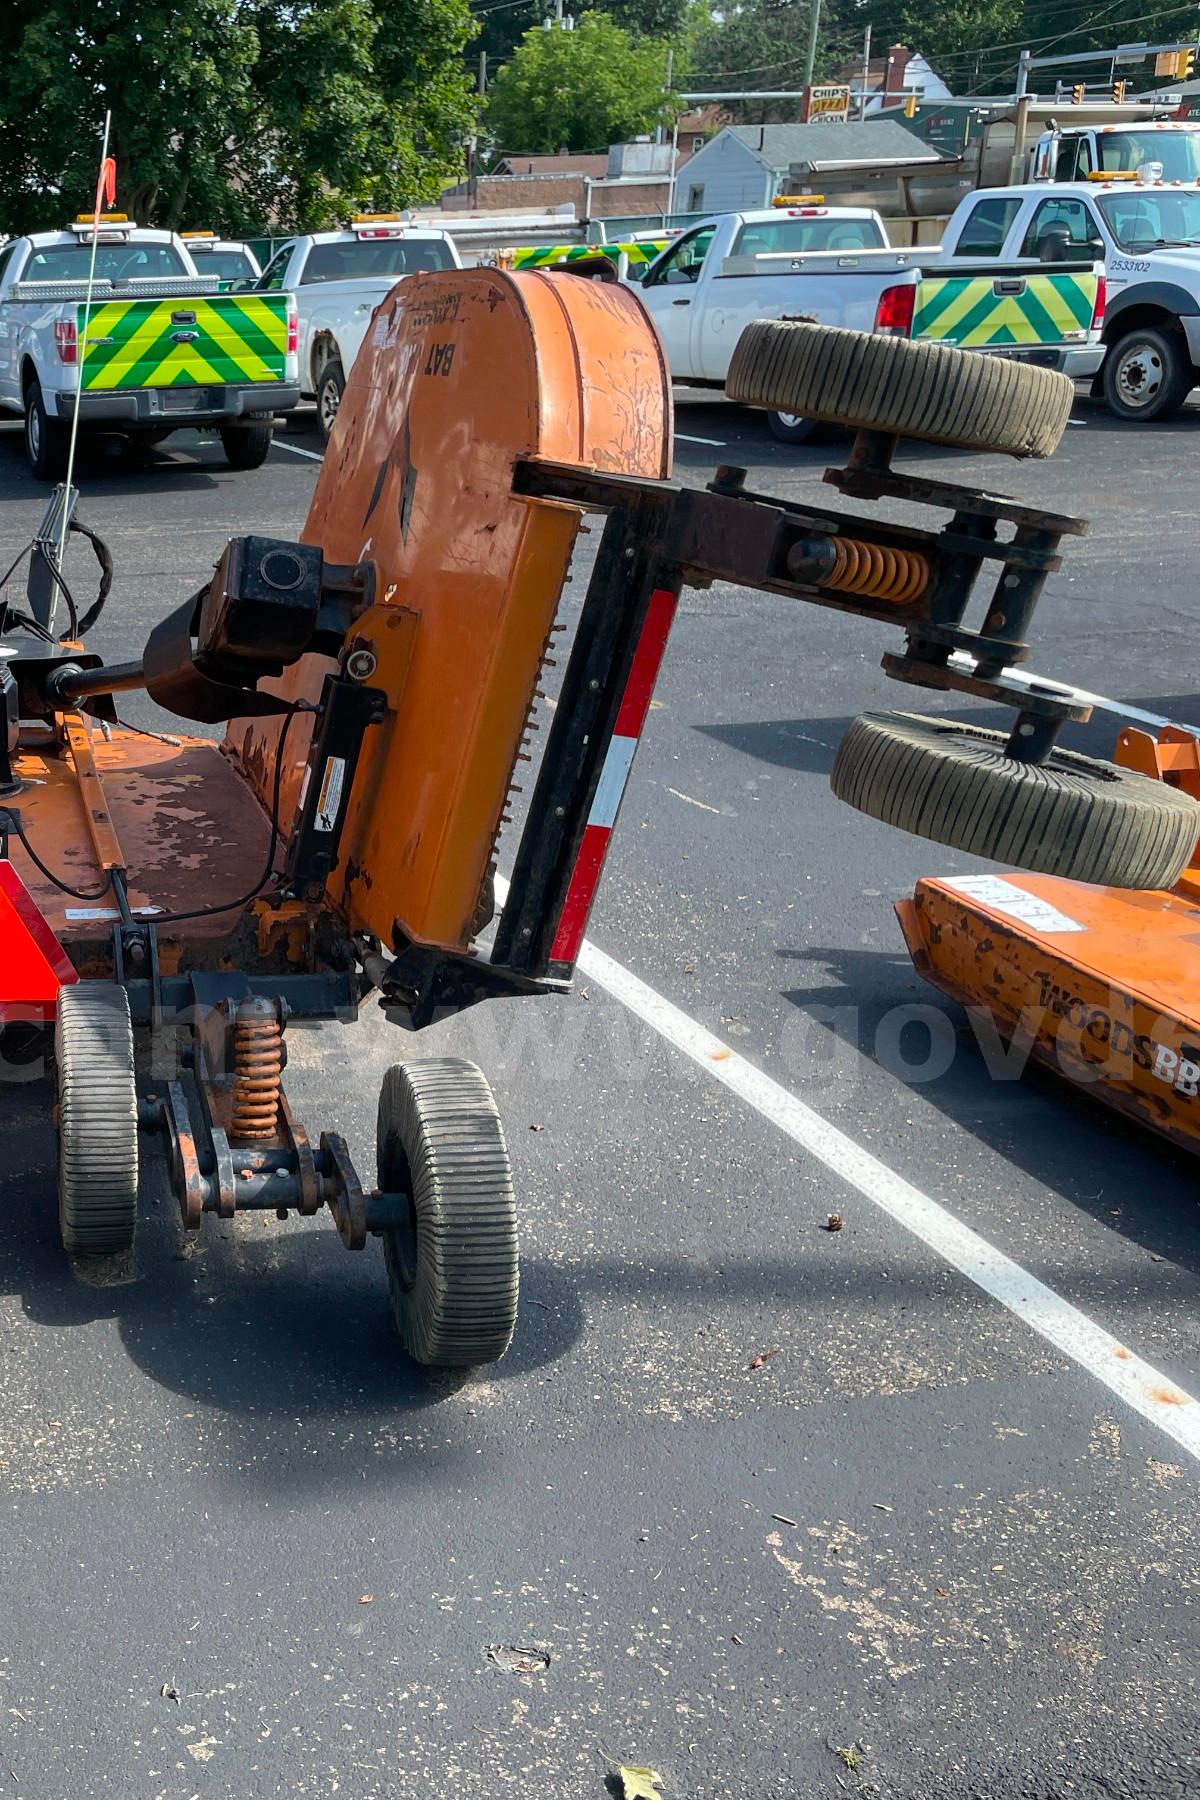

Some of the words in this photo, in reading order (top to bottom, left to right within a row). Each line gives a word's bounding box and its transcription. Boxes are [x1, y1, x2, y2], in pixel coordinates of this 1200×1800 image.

[813, 88, 848, 98] CHIP'S
[811, 97, 847, 113] PIZZA
[1110, 260, 1151, 273] 2533102
[425, 343, 456, 376] BAT
